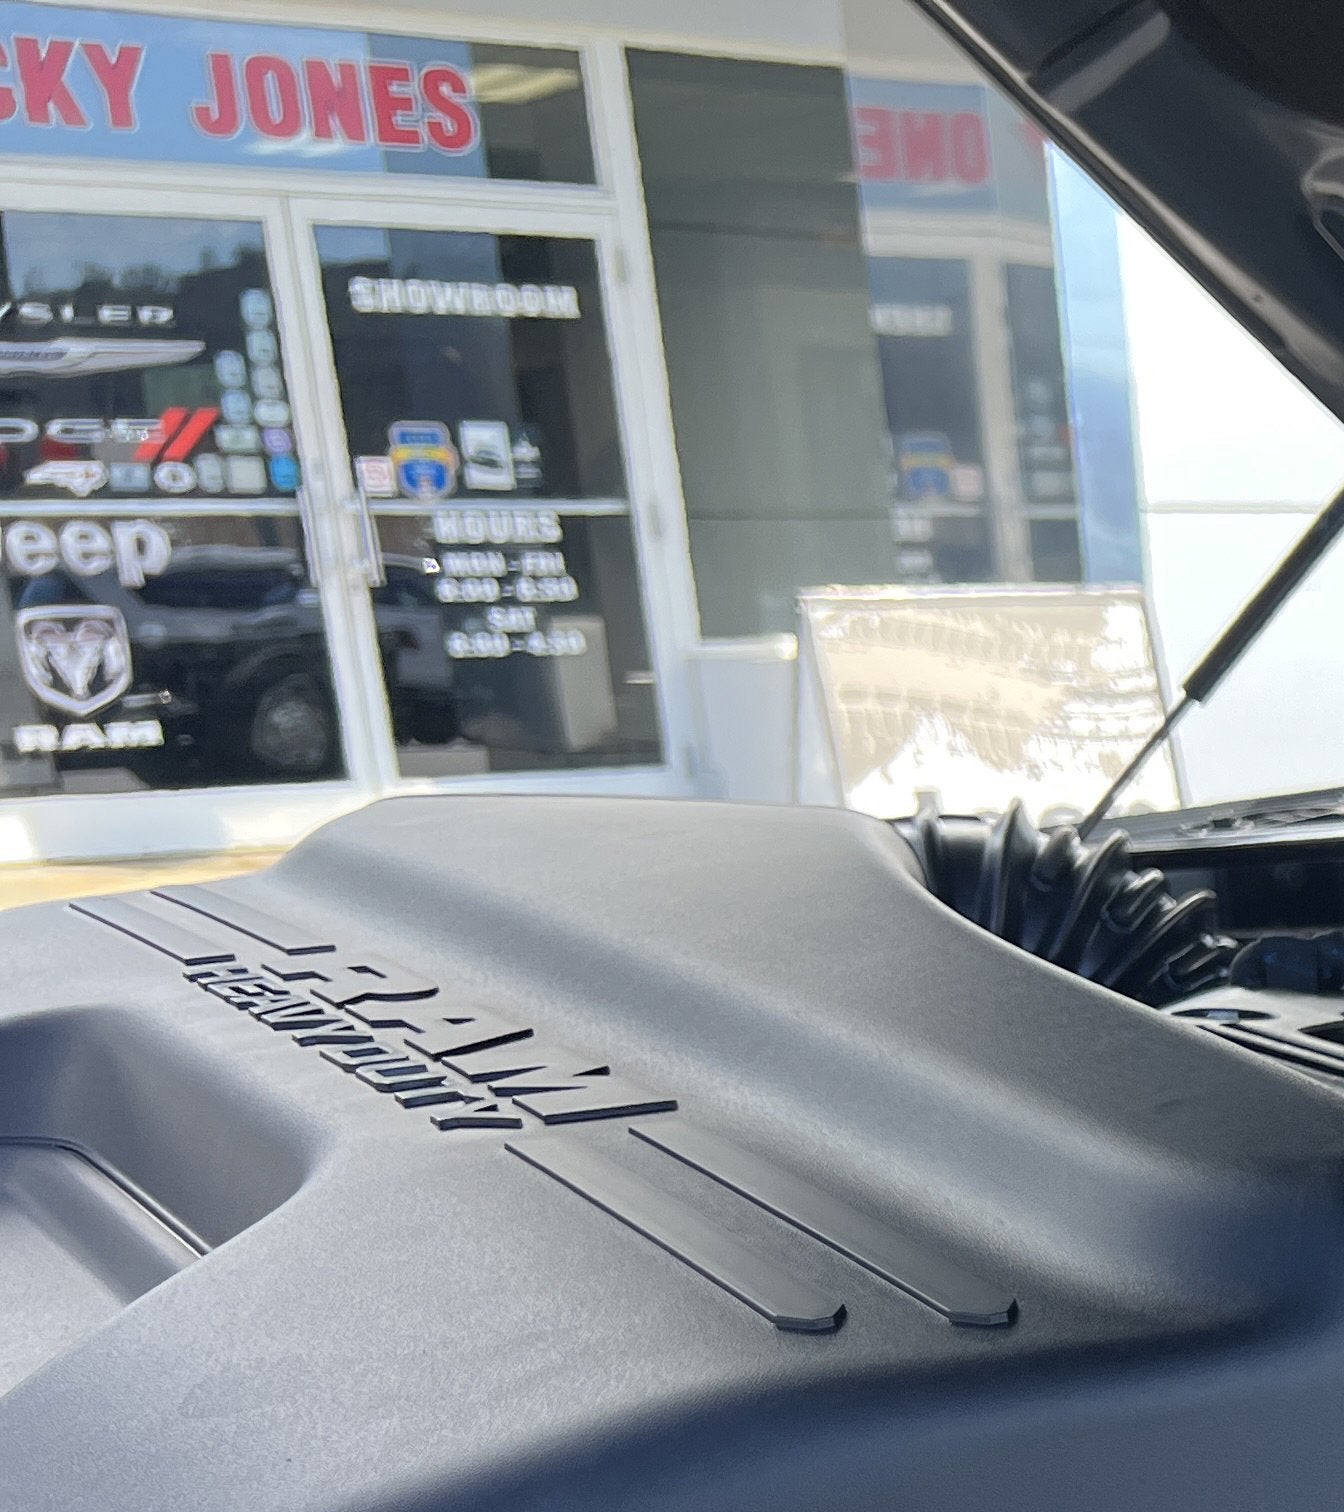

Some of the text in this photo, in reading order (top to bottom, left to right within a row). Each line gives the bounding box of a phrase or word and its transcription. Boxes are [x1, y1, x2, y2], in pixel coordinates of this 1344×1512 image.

[191, 50, 481, 157] JONES
[0, 301, 175, 327] SLER
[348, 276, 582, 319] SHOWROOM
[0, 518, 172, 588] eep
[433, 510, 564, 544] HOURS
[13, 719, 164, 753] RAM
[183, 964, 524, 1132] HEAVY DUTY
[261, 955, 679, 1125] RAM
